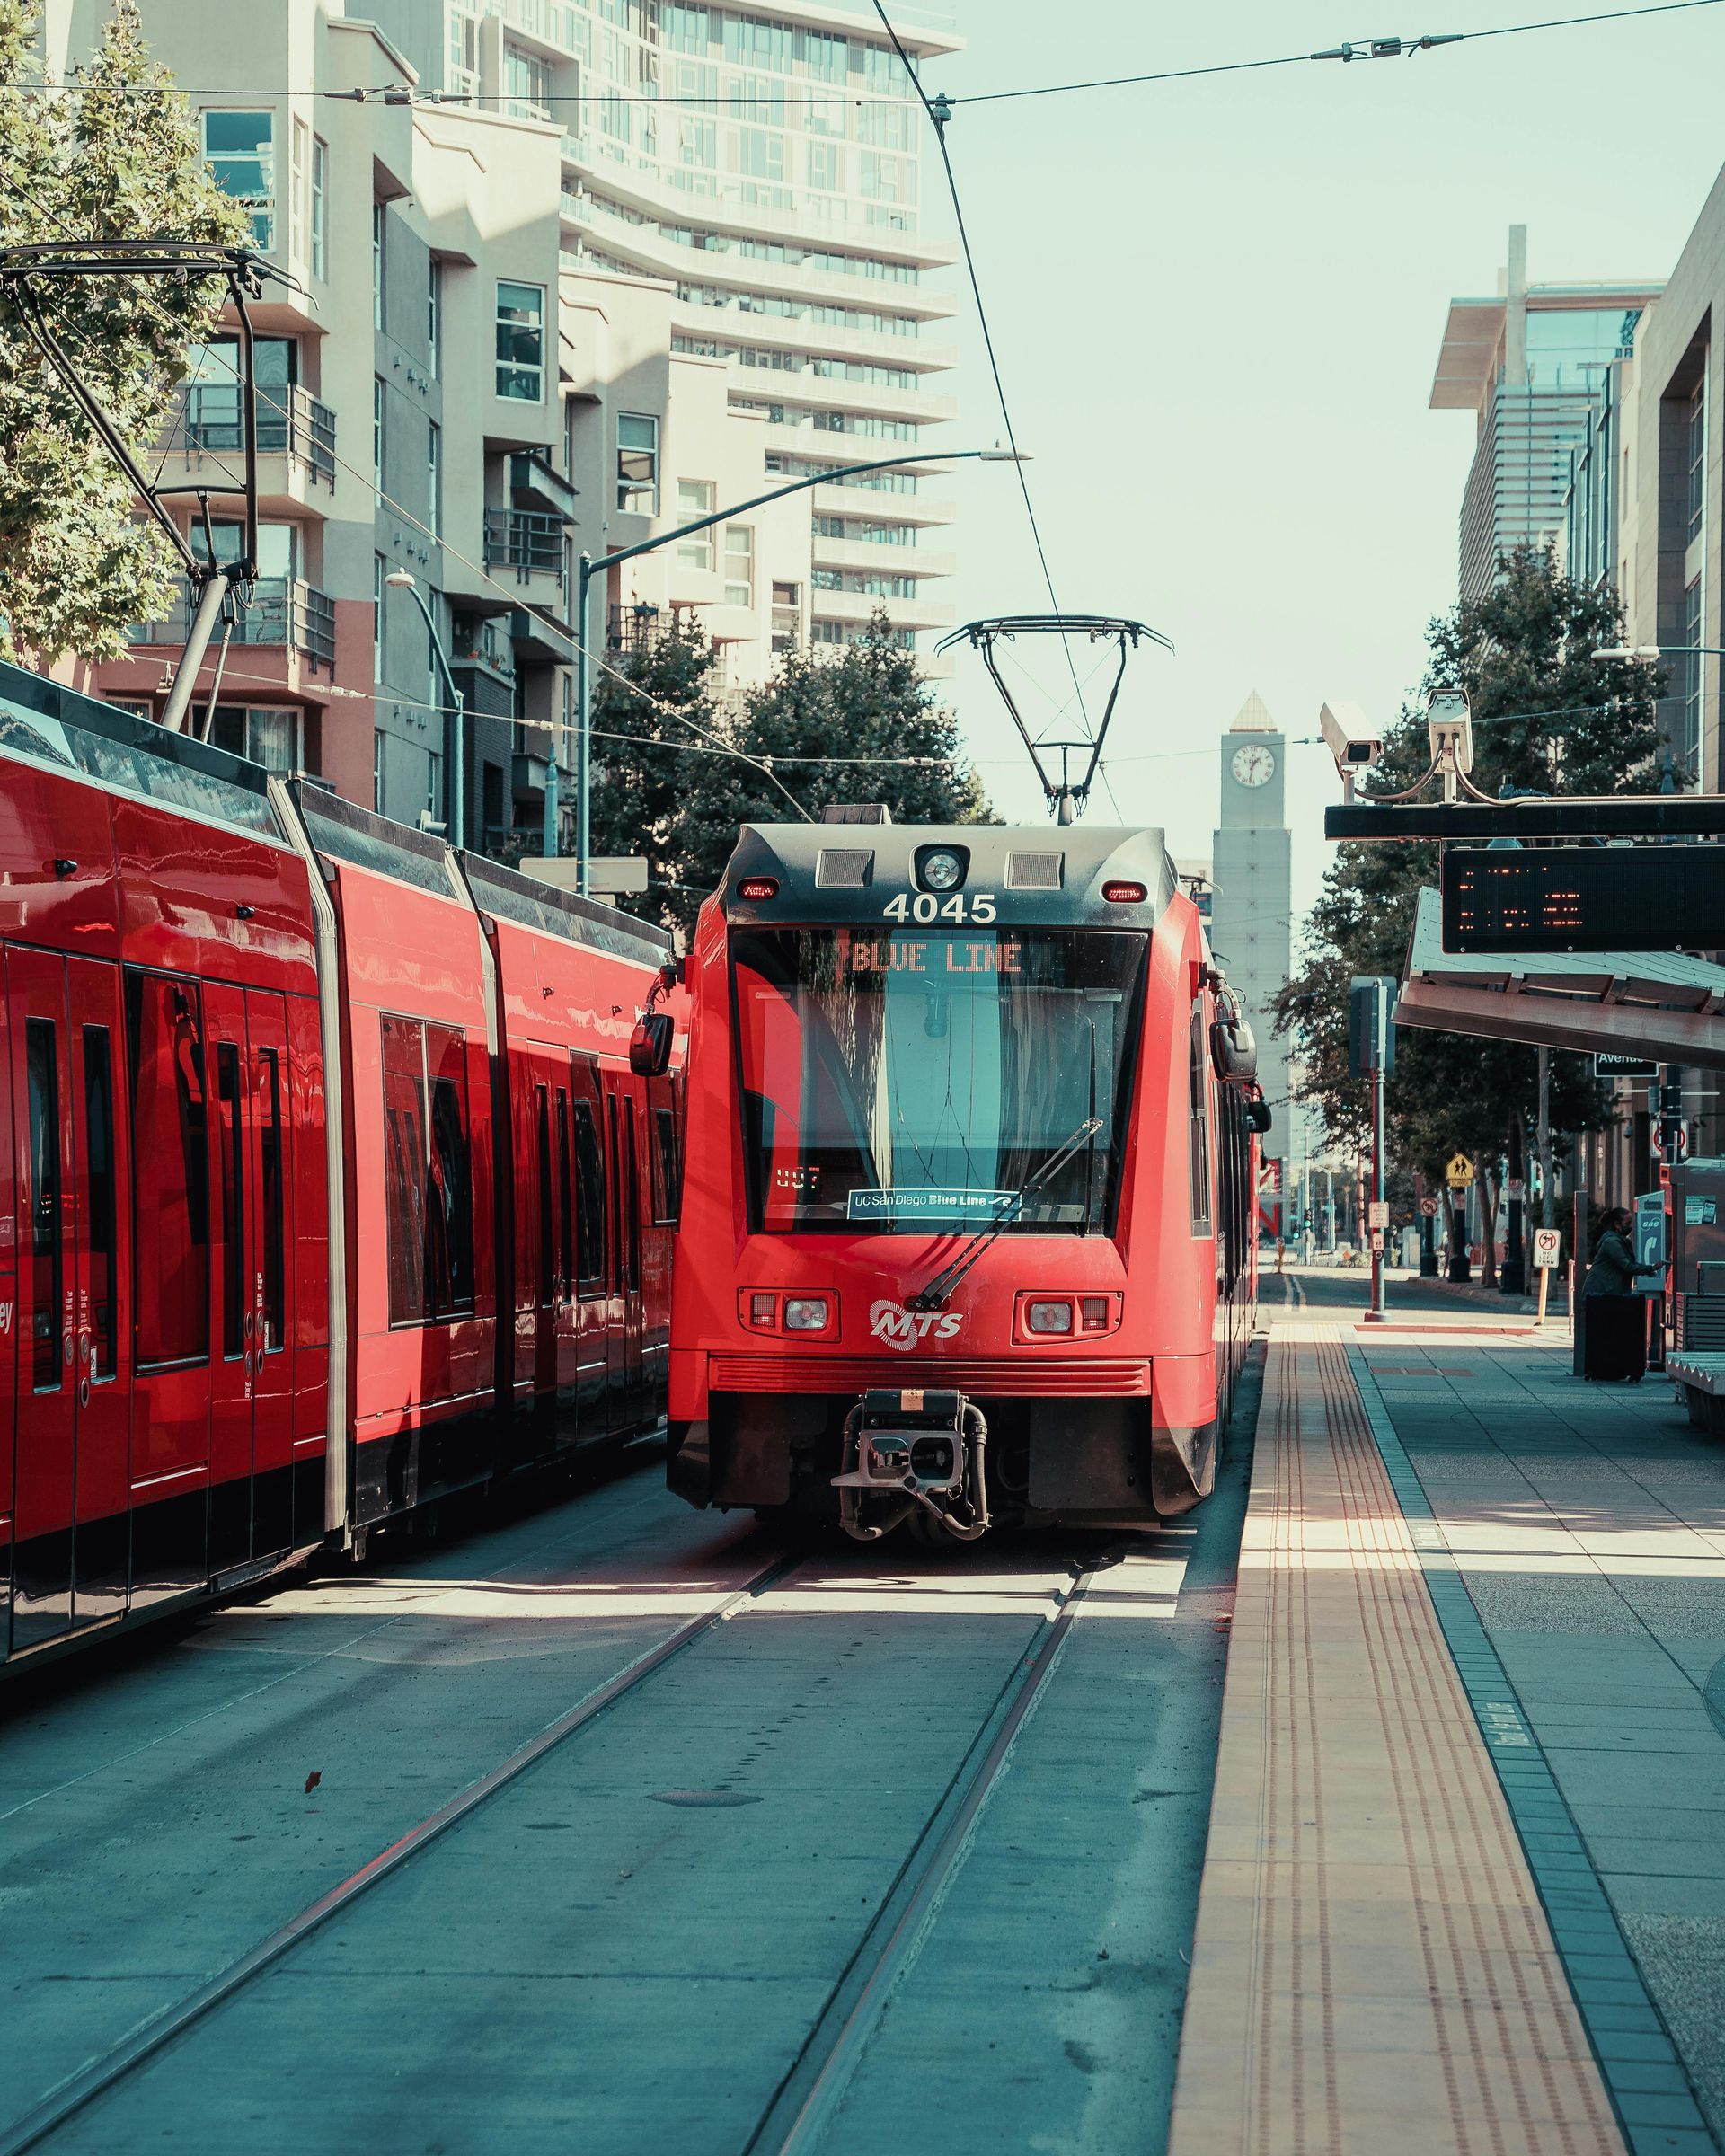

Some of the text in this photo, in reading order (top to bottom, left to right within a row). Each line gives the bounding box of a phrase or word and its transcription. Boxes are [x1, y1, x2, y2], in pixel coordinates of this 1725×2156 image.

[883, 893, 997, 924] 4045
[853, 943, 1022, 972] BLUE LINE
[854, 1194, 987, 1207] UC San Diego Blue Line
[870, 1312, 964, 1339] MTS
